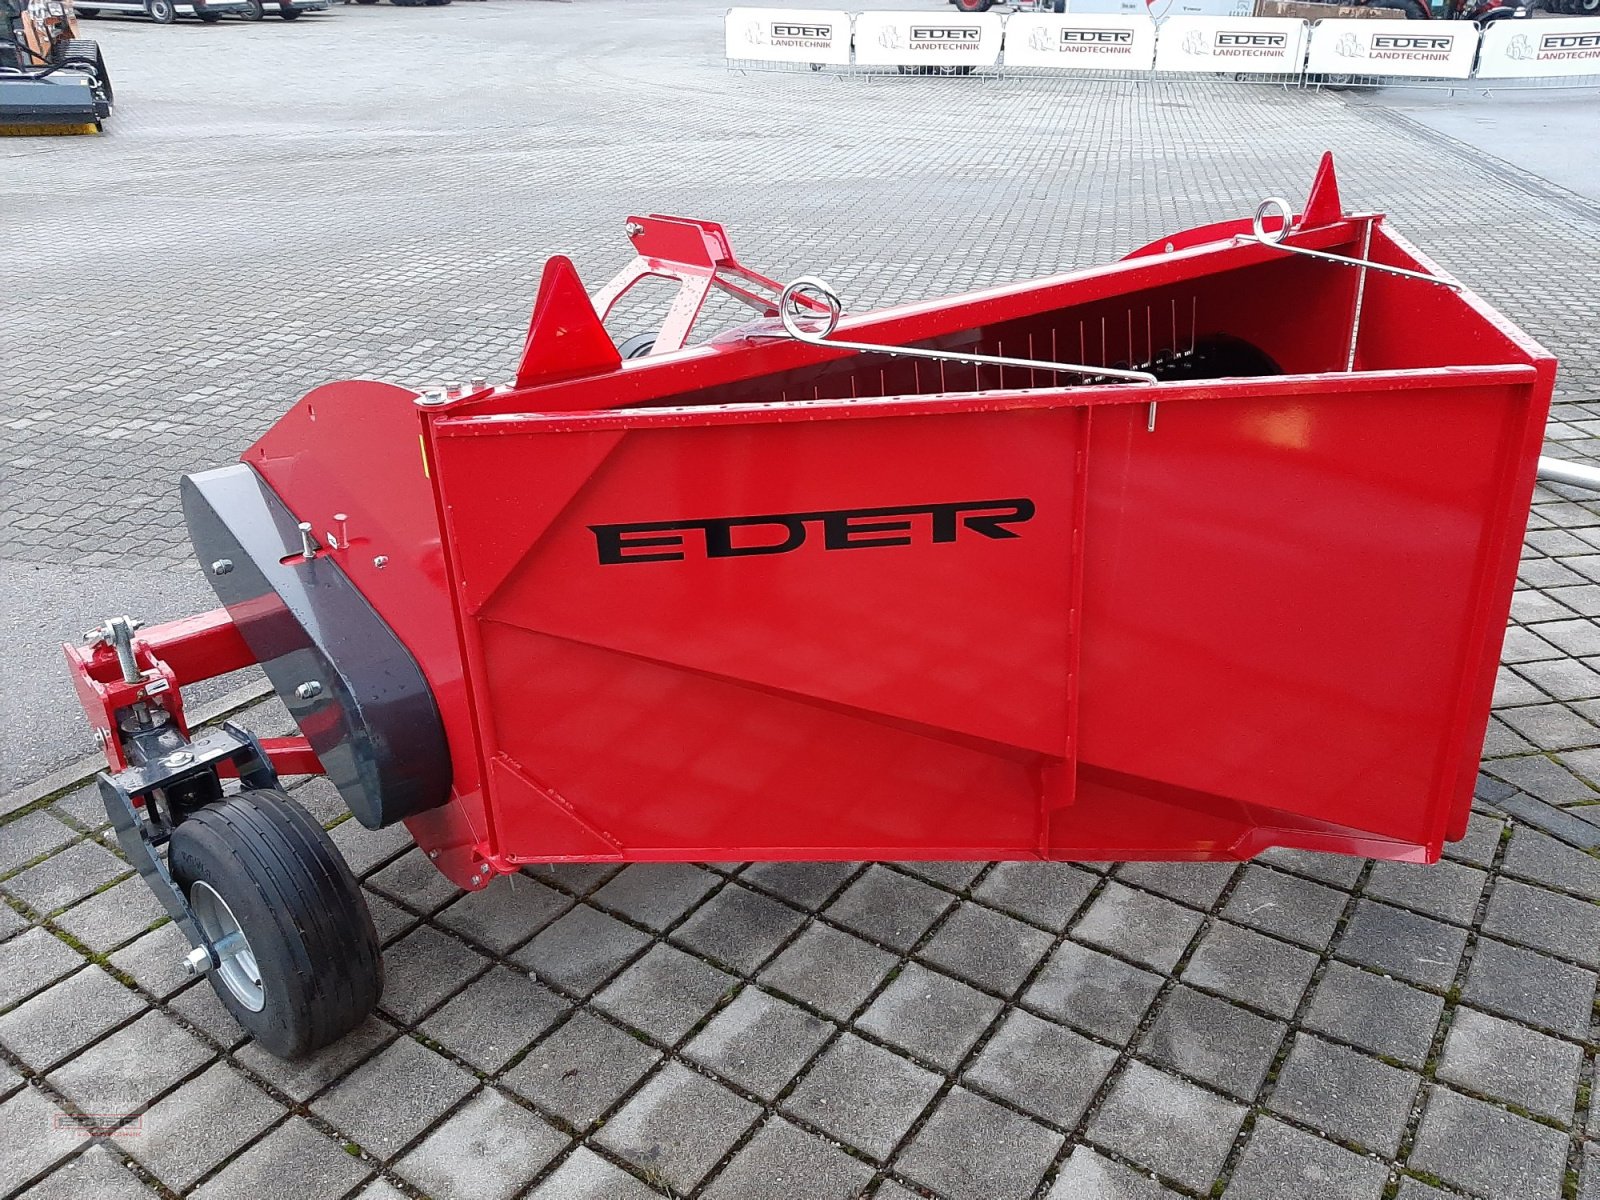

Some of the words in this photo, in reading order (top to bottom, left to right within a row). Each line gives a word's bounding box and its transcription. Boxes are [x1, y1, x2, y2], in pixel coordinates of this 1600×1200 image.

[773, 25, 830, 37] EDER
[912, 29, 979, 39] EDER
[1063, 31, 1132, 43] EDER
[1217, 34, 1286, 46] EDER
[771, 40, 831, 48] LANDTECHNIK
[1375, 37, 1450, 49] EDER
[1059, 45, 1132, 54] LANDTECHNIK
[1213, 49, 1285, 57] LANDTECHNIK
[1369, 52, 1450, 61] LANDTECHNIK
[586, 498, 1035, 565] EDER
